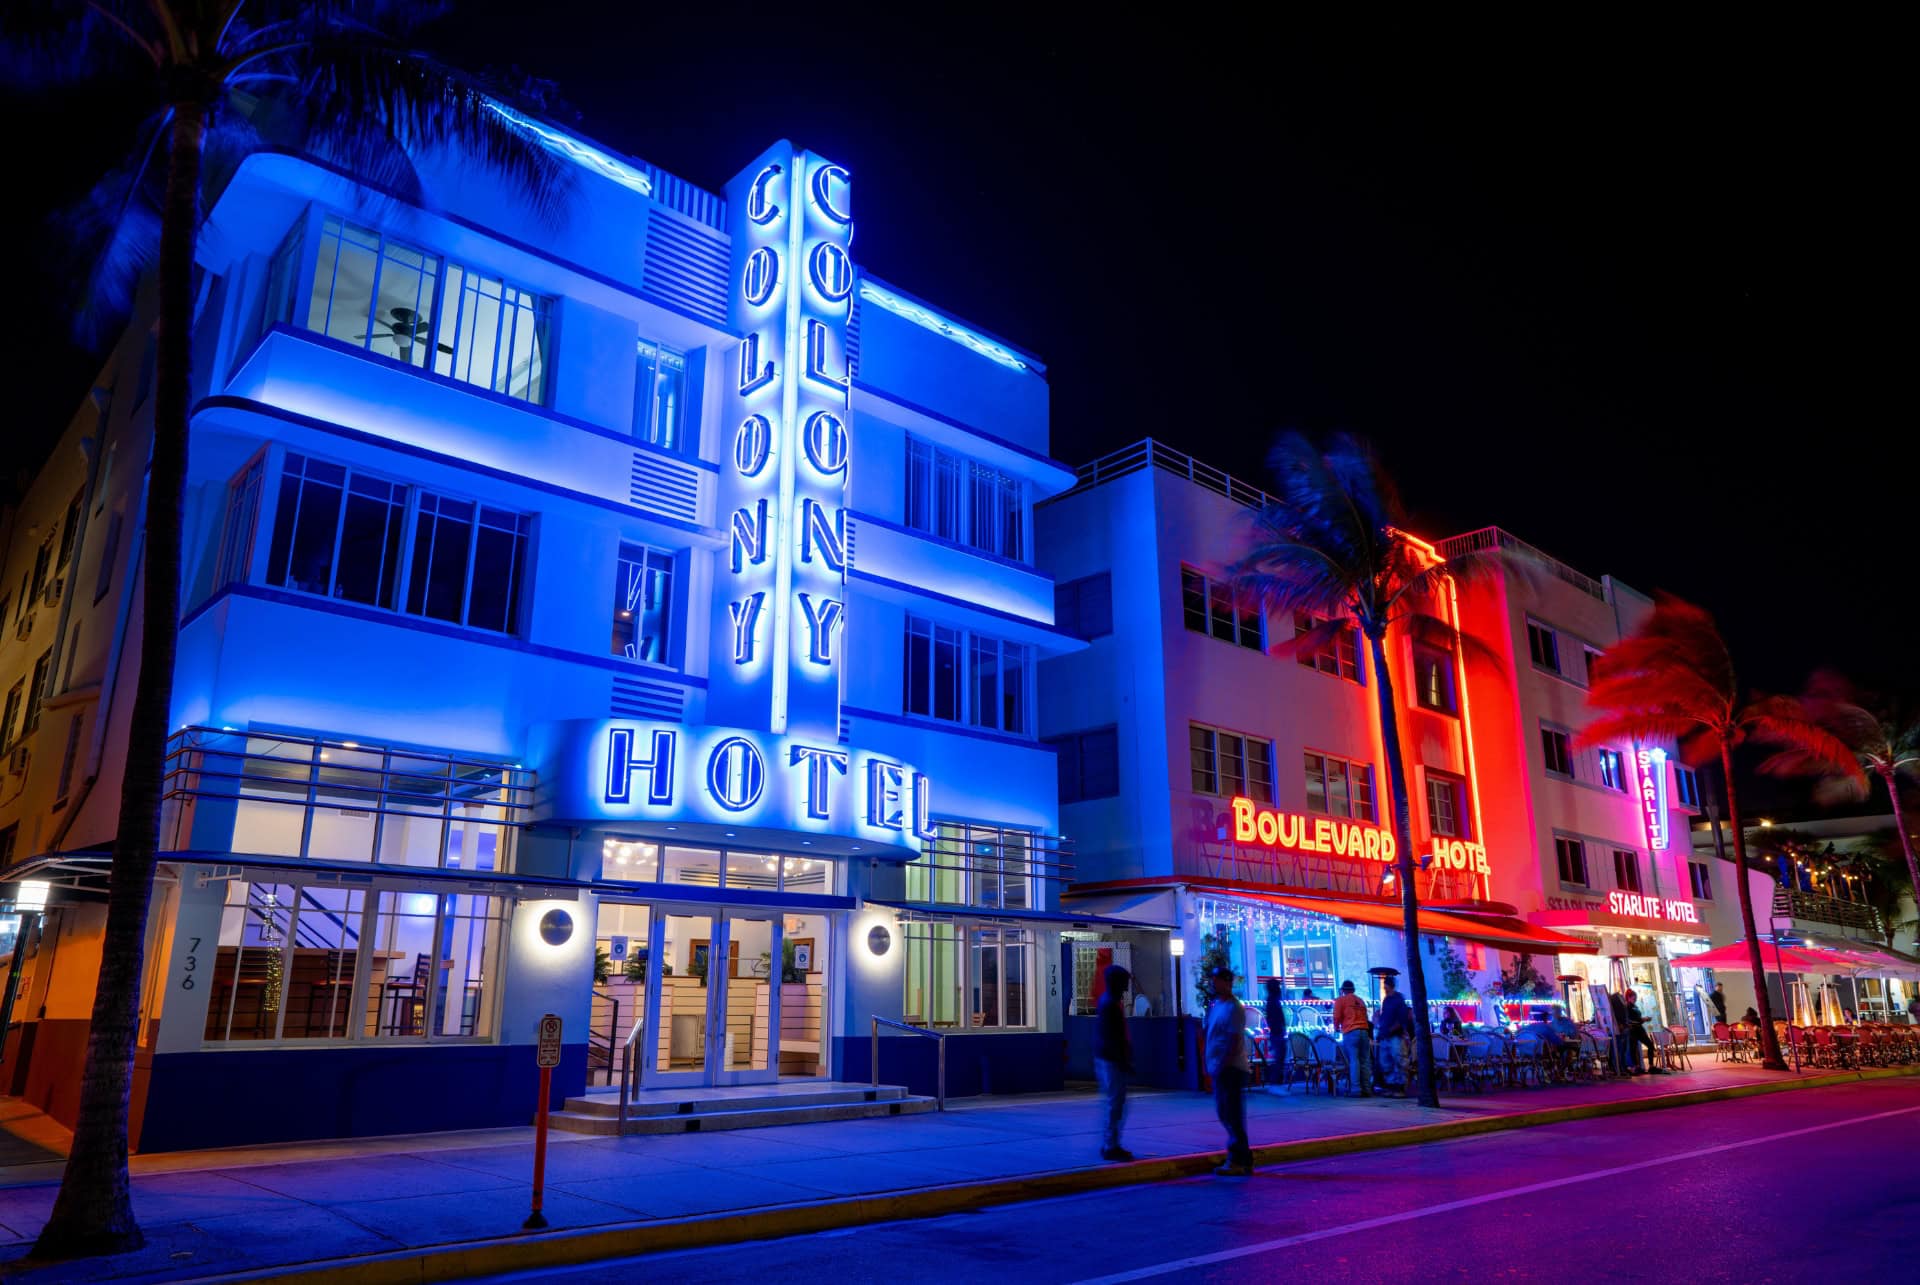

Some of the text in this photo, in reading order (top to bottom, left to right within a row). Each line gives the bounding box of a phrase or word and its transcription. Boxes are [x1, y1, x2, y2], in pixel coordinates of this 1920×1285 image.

[729, 163, 784, 665] COLONY
[798, 163, 853, 666] COLONY
[604, 727, 938, 842] HOTEL
[1637, 750, 1664, 851] STARLITE
[1231, 795, 1492, 876] BOULEVARD HOTEL
[1608, 891, 1699, 923] STARLITE HOTEL
[182, 937, 201, 990] 736
